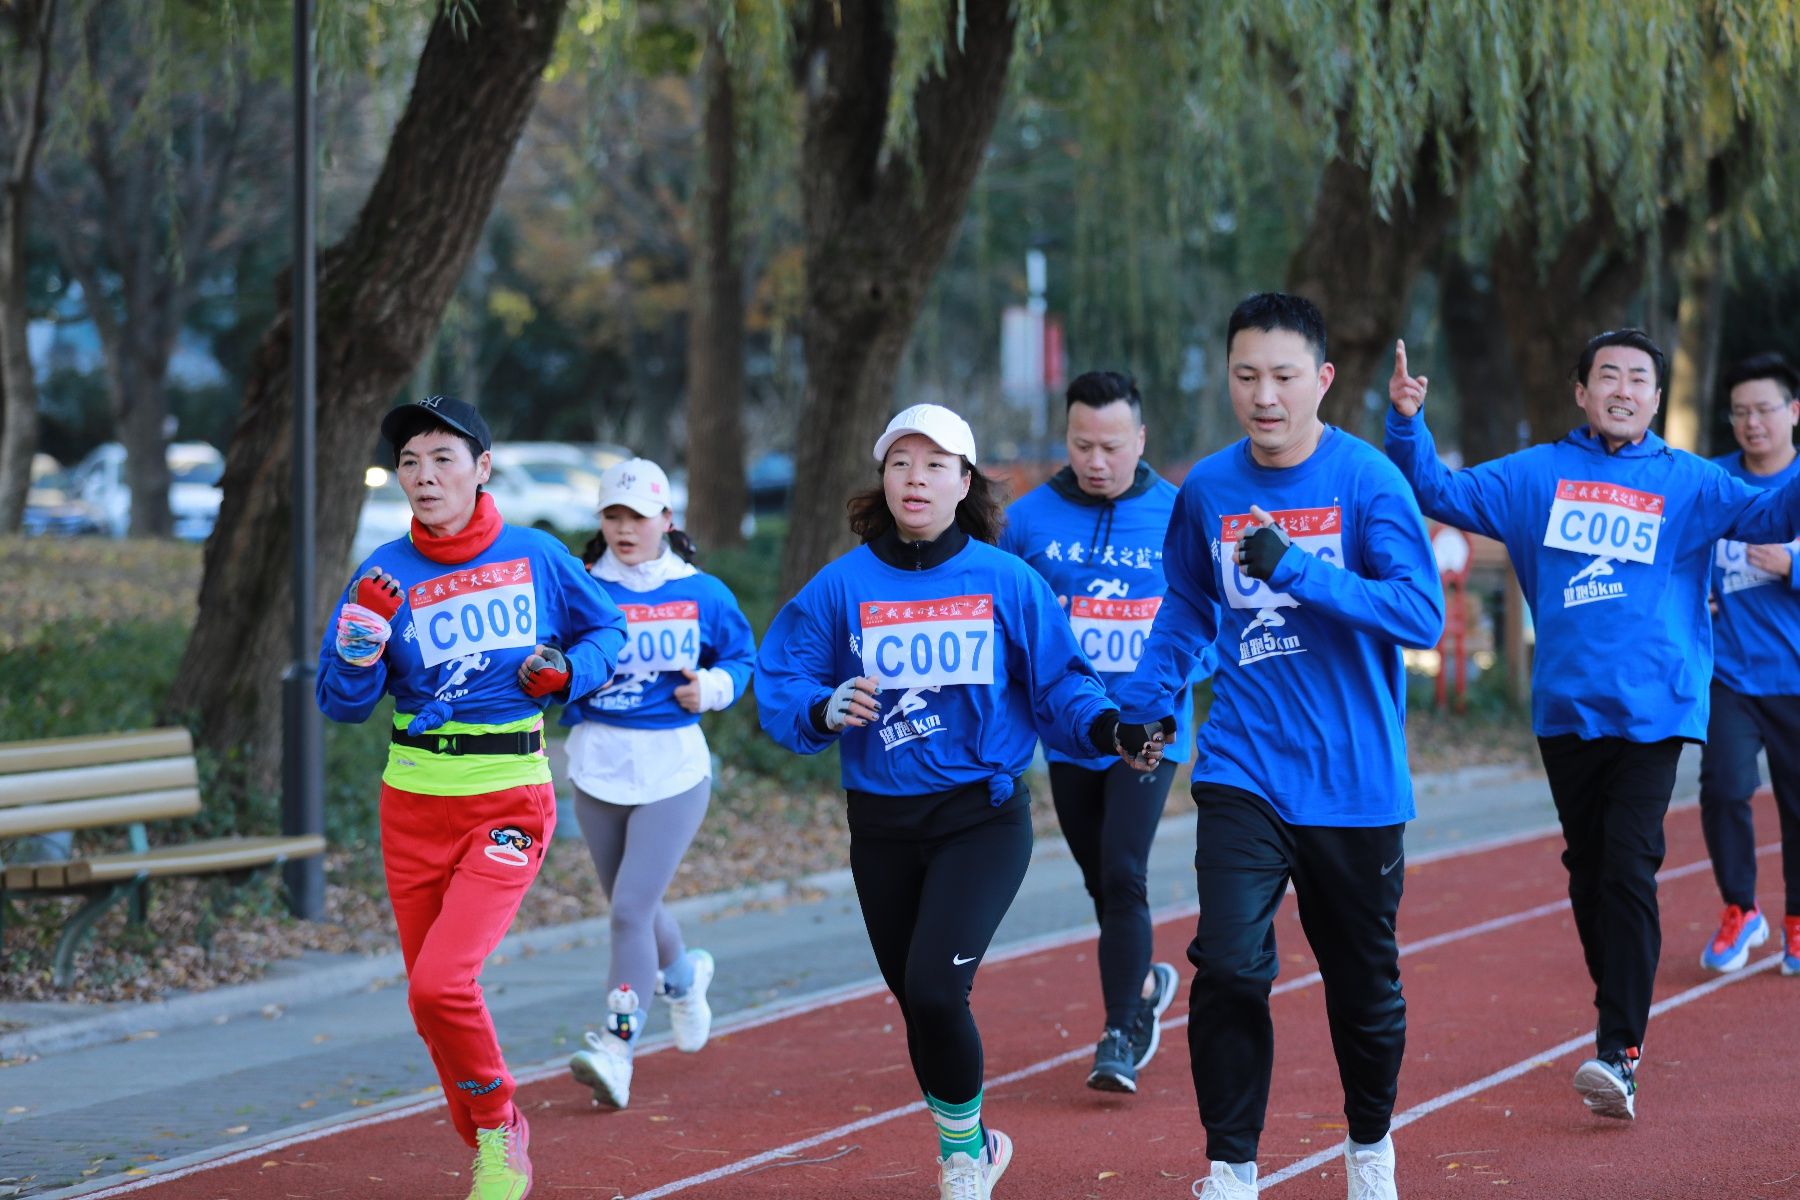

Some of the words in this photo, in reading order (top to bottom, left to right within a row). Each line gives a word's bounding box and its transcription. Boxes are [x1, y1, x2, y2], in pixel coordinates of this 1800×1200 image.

[1560, 510, 1654, 553] C005
[429, 593, 533, 650] C008
[875, 630, 989, 678] C007
[1081, 628, 1146, 662] C00
[878, 714, 942, 745] 健跑km
